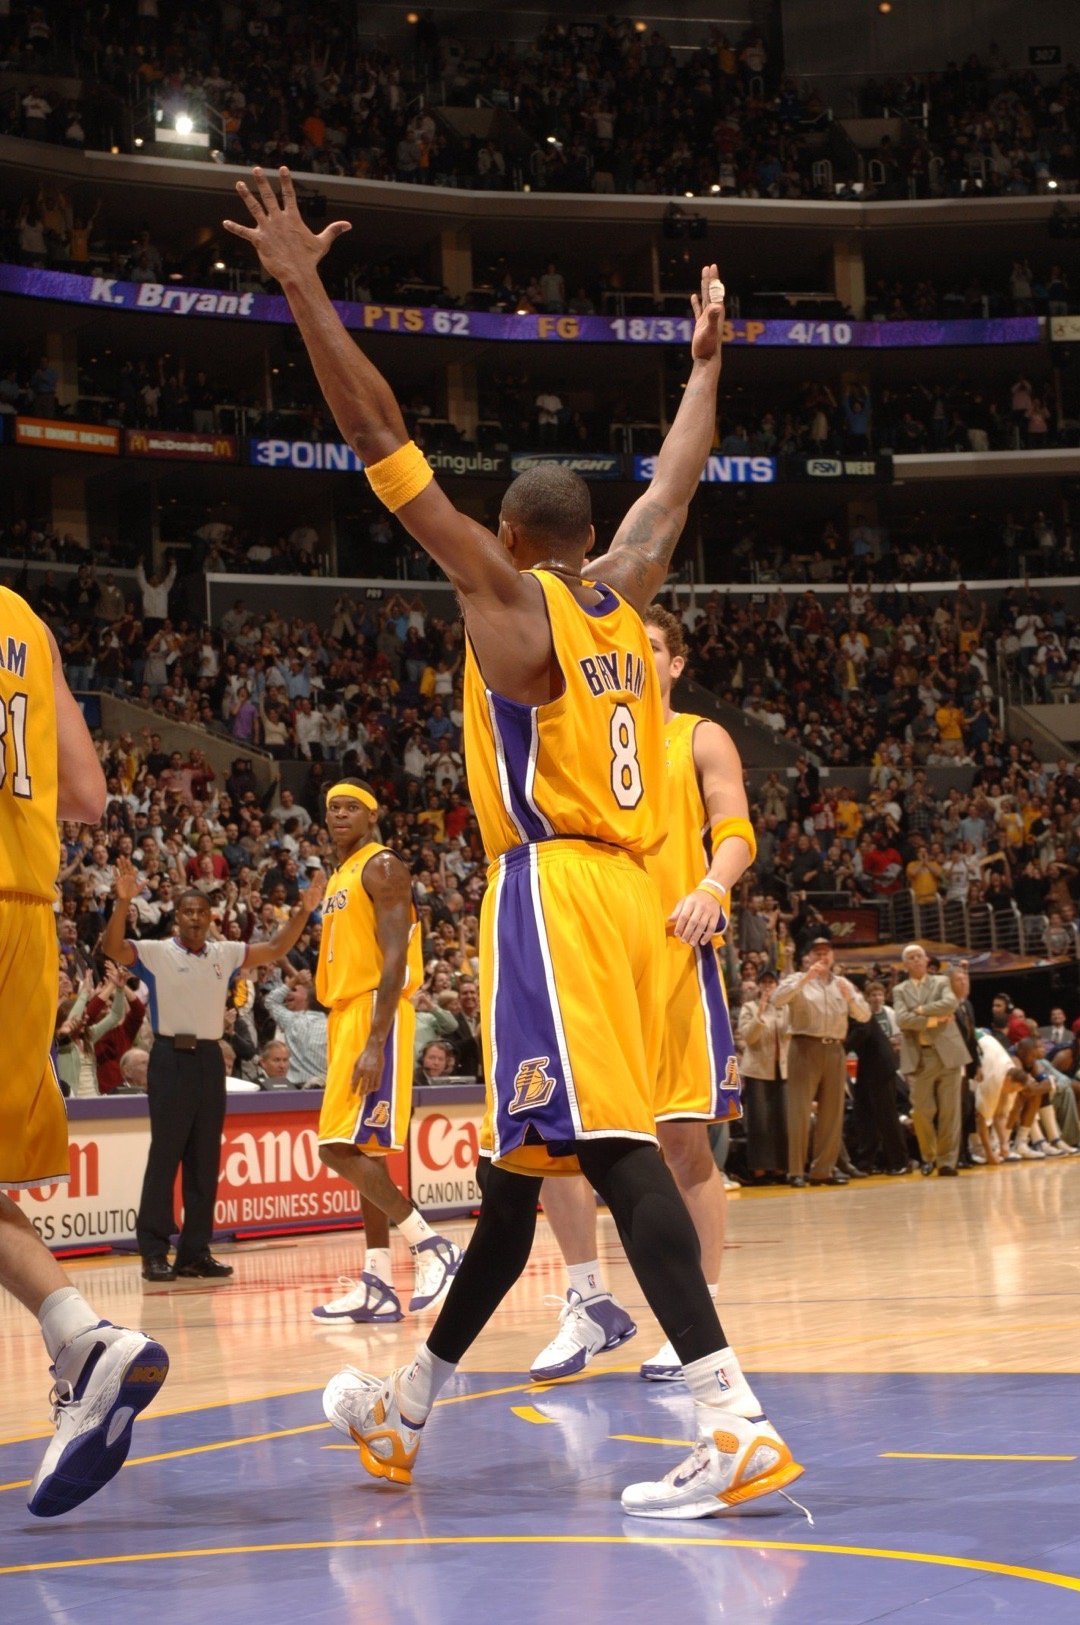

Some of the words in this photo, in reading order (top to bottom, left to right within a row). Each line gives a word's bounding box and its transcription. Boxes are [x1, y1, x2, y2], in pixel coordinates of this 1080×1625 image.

[90, 277, 124, 303] K.
[137, 282, 254, 315] Bryant
[363, 305, 424, 332] PTS
[432, 311, 470, 336] 62
[537, 316, 580, 339] FG
[610, 318, 691, 341] 18/31
[788, 322, 852, 345] 4/10
[256, 439, 364, 472] 3POINT
[427, 450, 503, 475] cingular
[609, 702, 644, 811] 8
[218, 1129, 340, 1187] ano
[242, 1191, 318, 1221] BUSINESS
[418, 1181, 463, 1205] CANON
[61, 1208, 137, 1239] SOLUTIO
